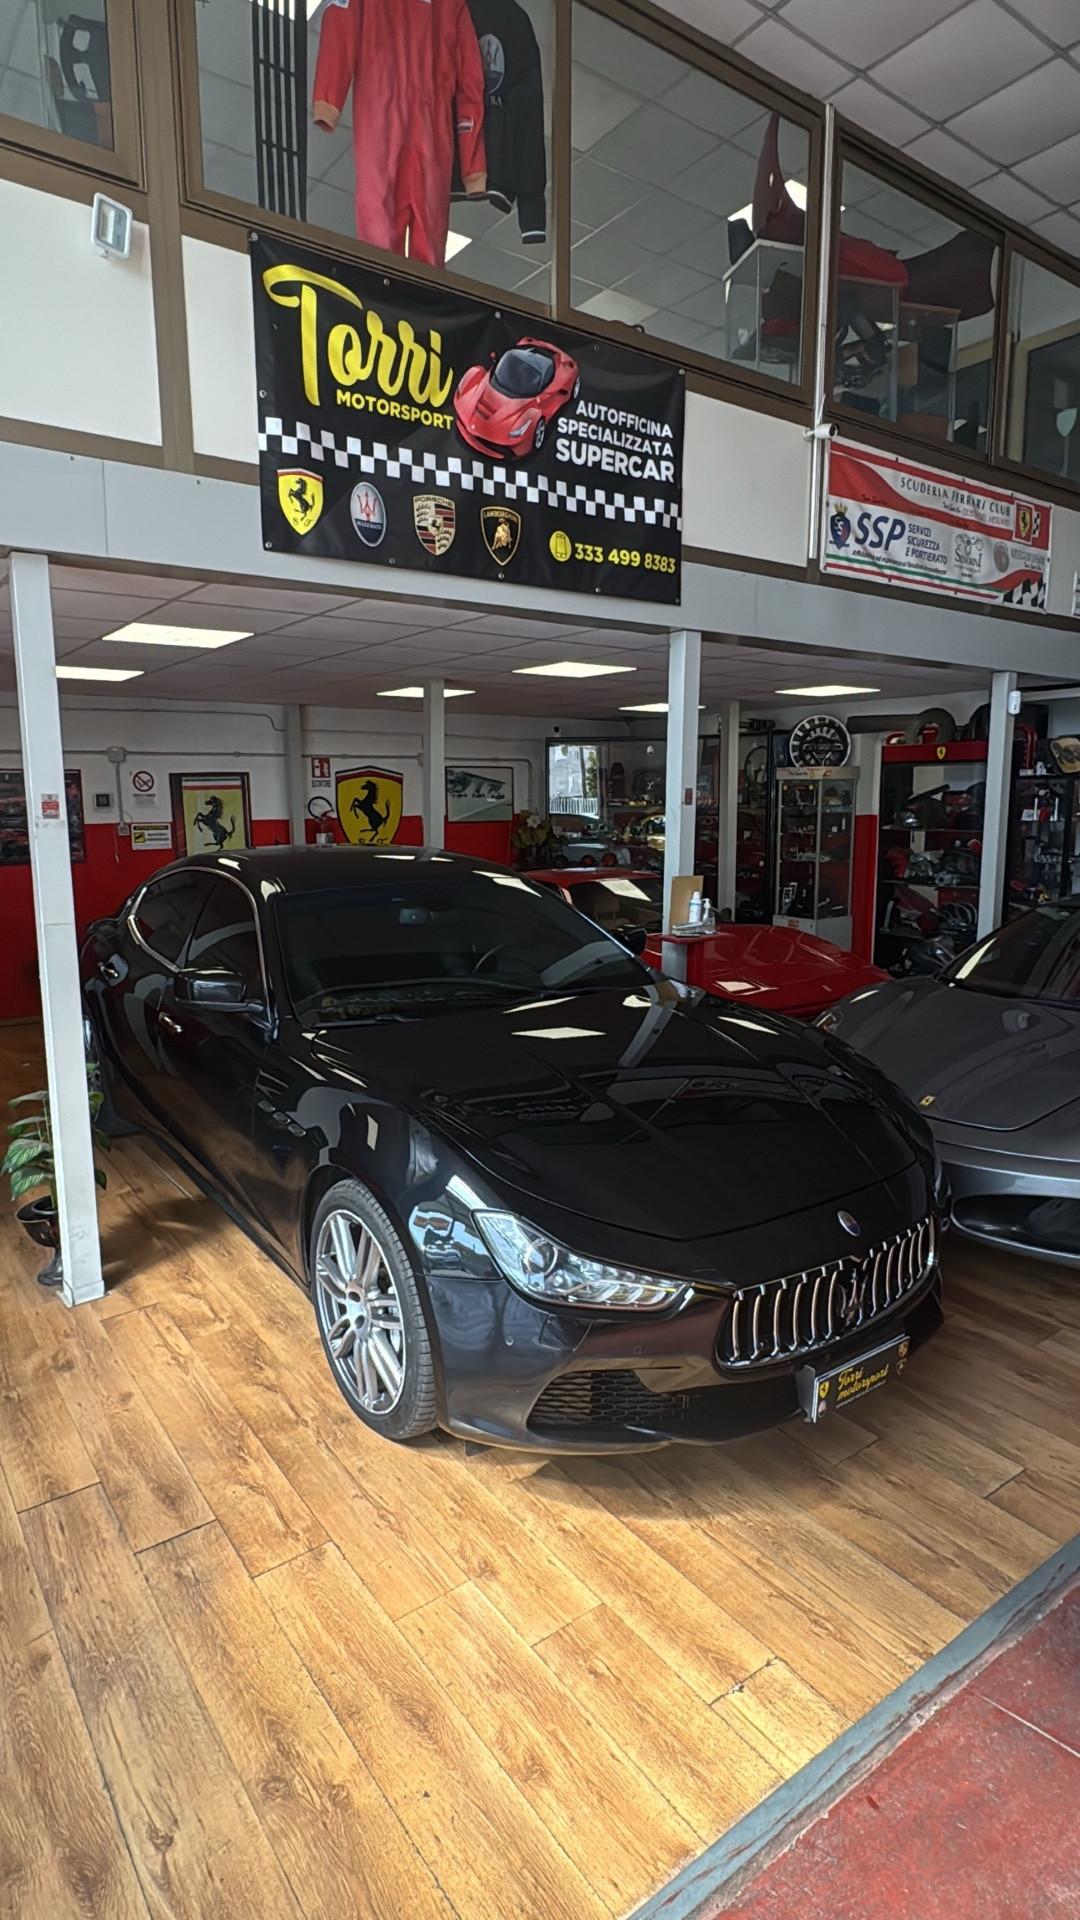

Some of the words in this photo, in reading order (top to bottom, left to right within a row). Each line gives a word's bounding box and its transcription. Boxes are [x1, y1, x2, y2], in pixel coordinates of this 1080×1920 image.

[262, 263, 456, 410] Torri
[336, 389, 454, 432] MOTORSPORT
[576, 400, 673, 439] AUTOFFICINA
[557, 417, 674, 458] SPECIALIZZATA
[555, 439, 675, 484] SUPERCAR
[414, 497, 454, 507] PORSCHE
[900, 476, 949, 499] SCUDERIA
[950, 490, 986, 511] FERRARI
[989, 502, 1011, 517] CLUB
[854, 511, 906, 551] SSP
[907, 535, 940, 551] SICUREZZA
[908, 523, 932, 538] SERVIZI
[574, 542, 604, 563] 333
[608, 547, 641, 567] 499
[644, 552, 676, 575] 8383
[905, 546, 910, 556] E
[911, 548, 948, 565] PORTIERATO
[838, 1367, 863, 1390] Torri
